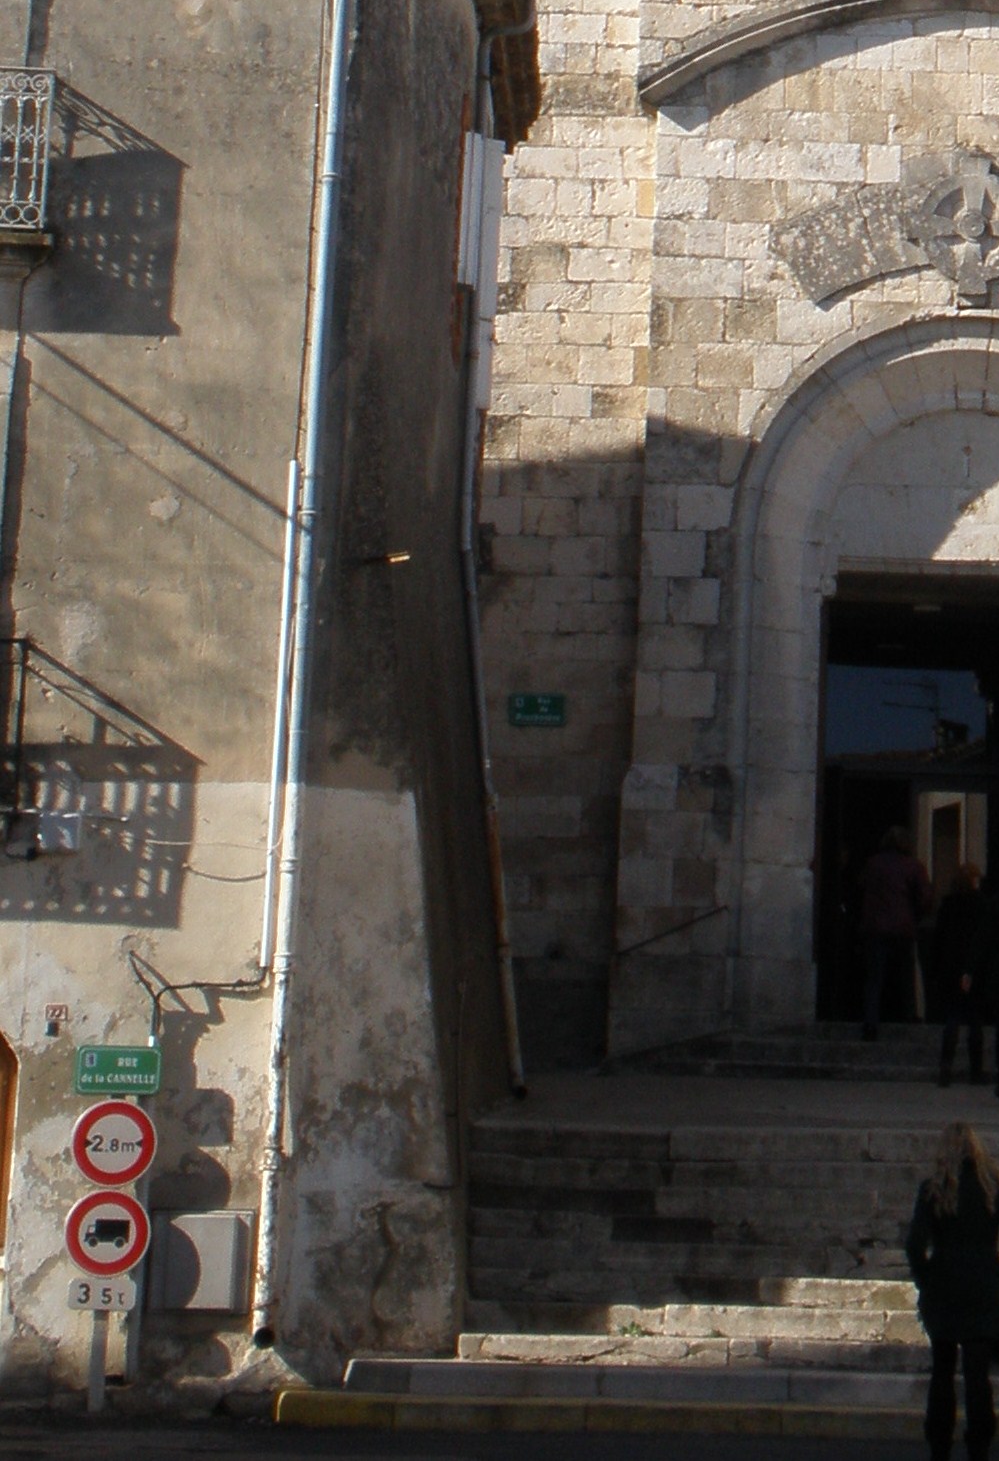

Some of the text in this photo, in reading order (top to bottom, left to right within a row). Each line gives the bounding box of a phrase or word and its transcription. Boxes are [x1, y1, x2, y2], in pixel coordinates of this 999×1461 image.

[117, 1057, 138, 1068] RUE
[80, 1072, 155, 1084] de la CANNELLE
